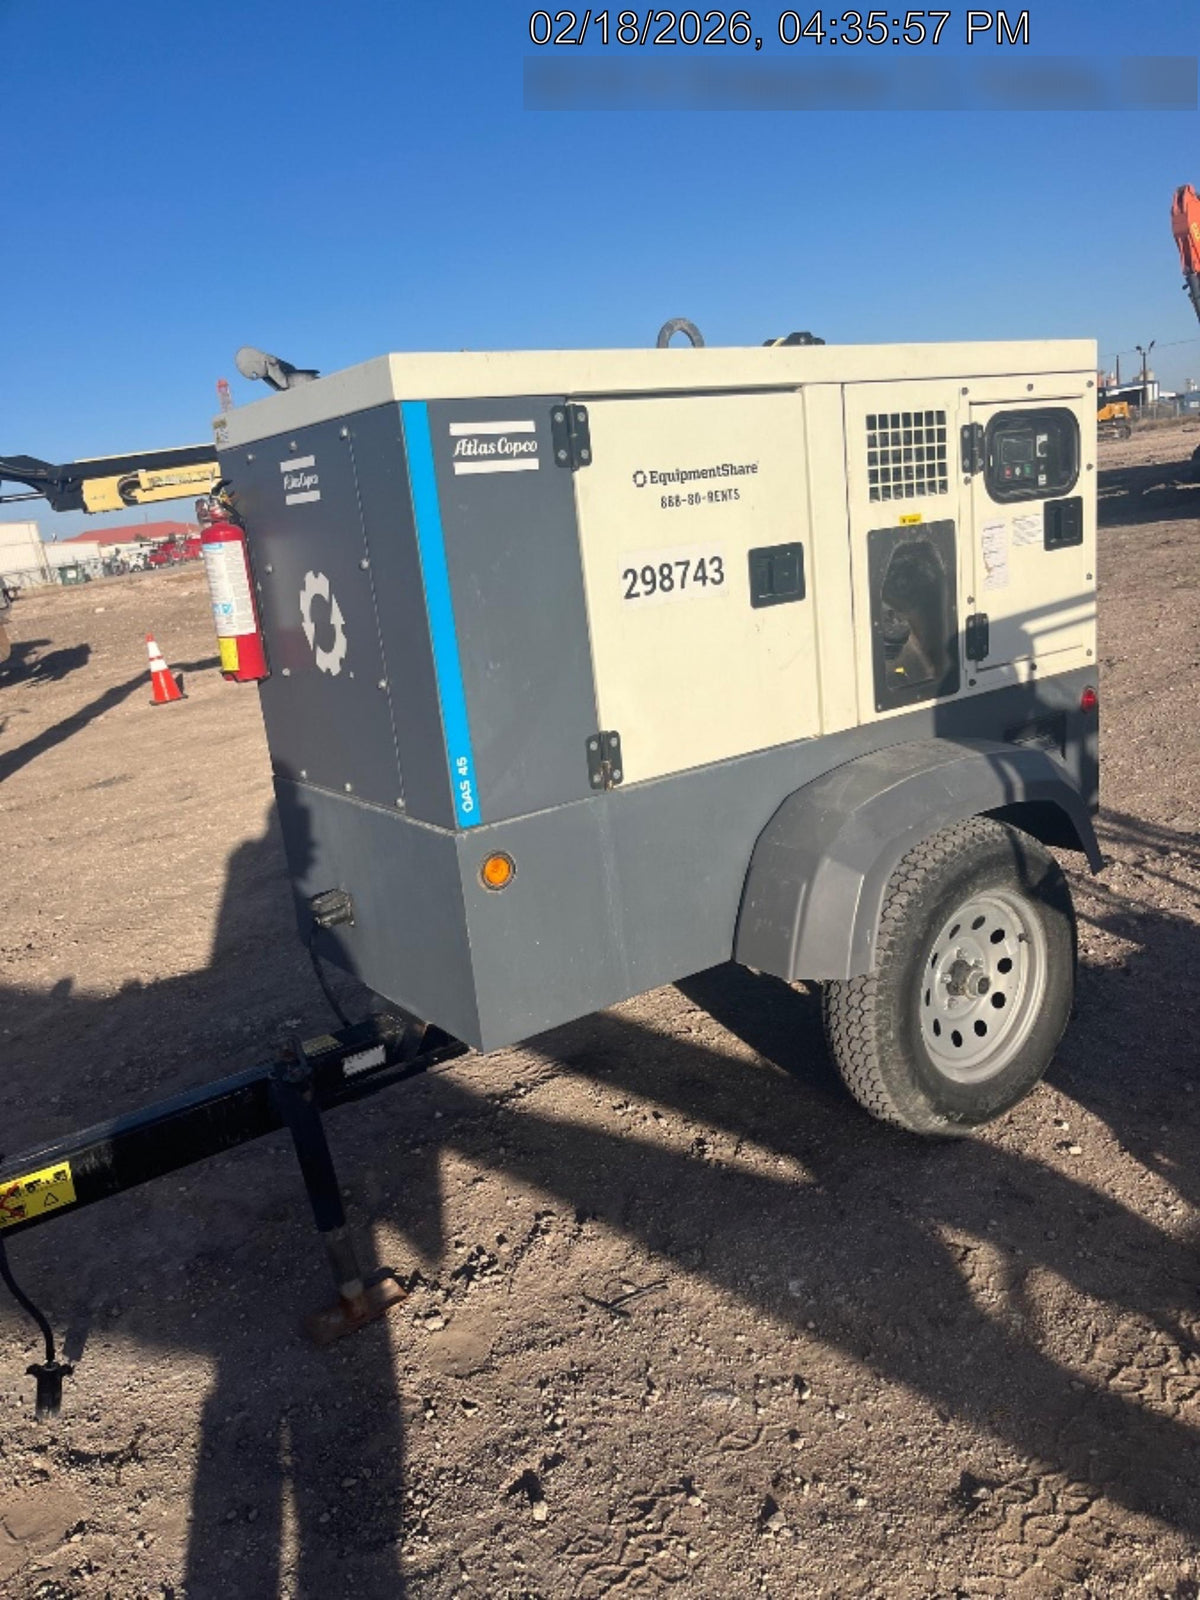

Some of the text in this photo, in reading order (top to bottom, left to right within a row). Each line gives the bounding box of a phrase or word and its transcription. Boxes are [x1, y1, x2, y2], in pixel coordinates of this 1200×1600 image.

[452, 437, 538, 457] Atlas Copco
[649, 463, 758, 486] EquipmentShare
[622, 556, 725, 600] 298743
[456, 756, 473, 813] QAS 45
